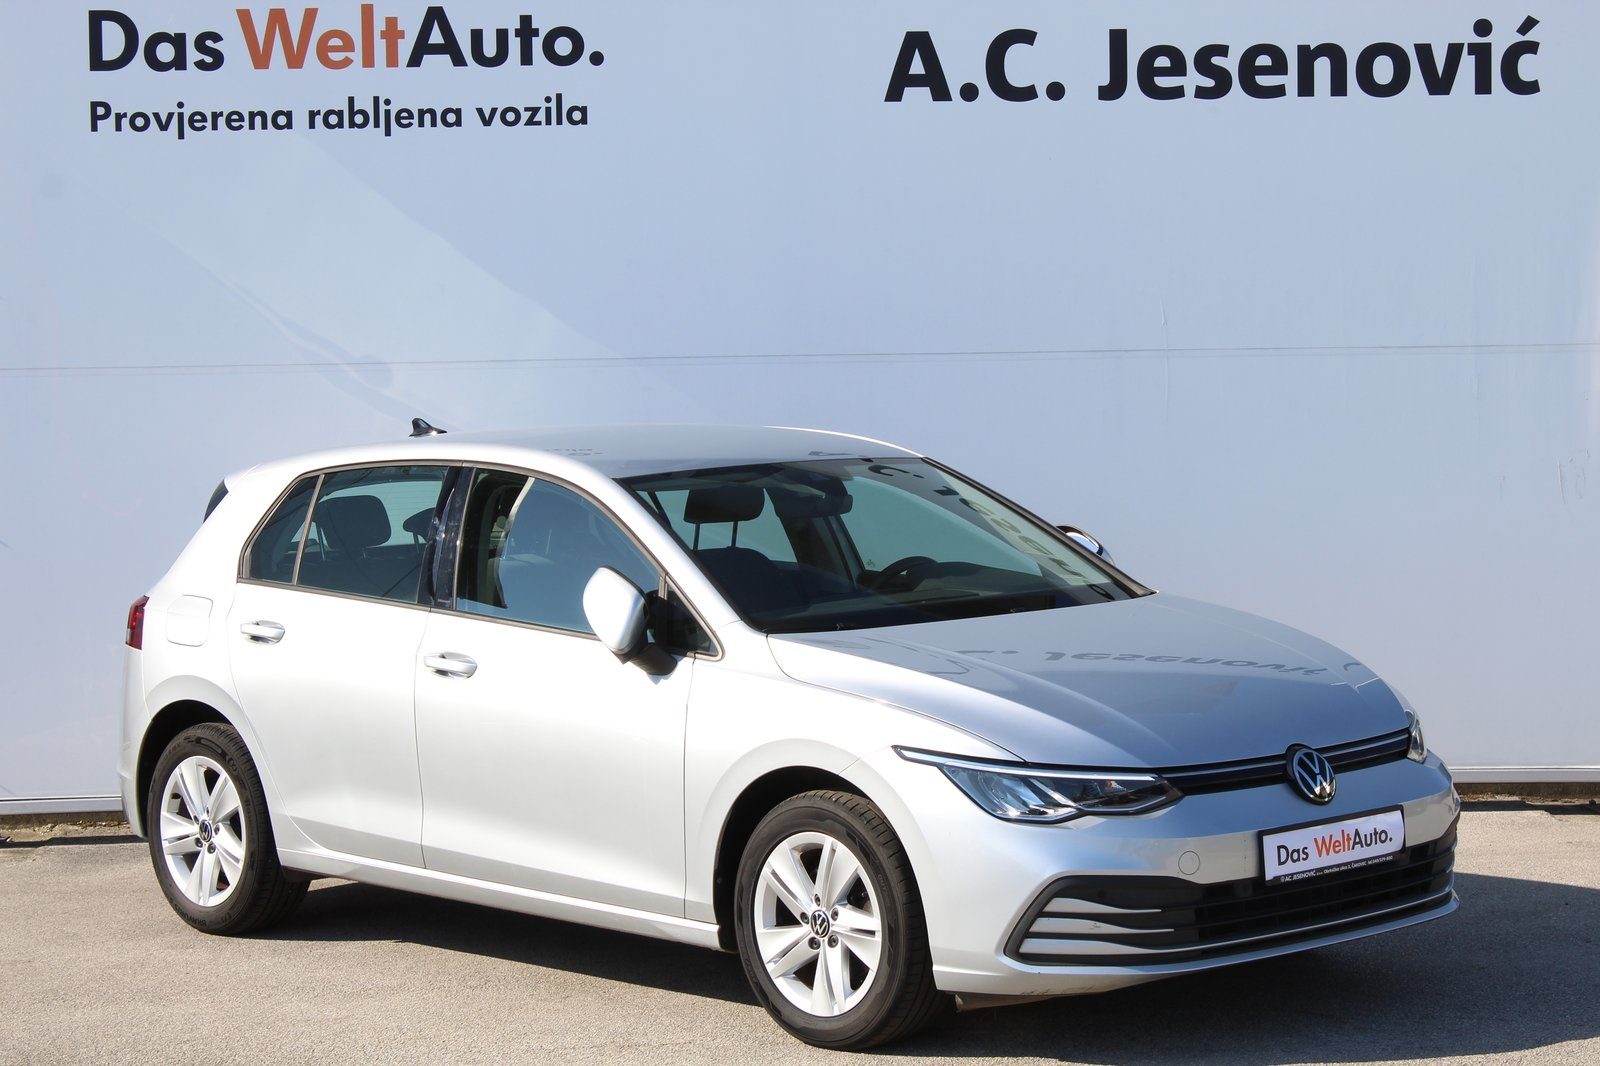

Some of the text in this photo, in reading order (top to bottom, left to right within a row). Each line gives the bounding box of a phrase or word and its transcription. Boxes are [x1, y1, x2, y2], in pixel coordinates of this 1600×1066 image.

[89, 3, 605, 72] Das WeltAuto.
[885, 15, 1541, 103] A.C. Jesenović
[90, 92, 588, 140] Provjerena rabljena vozila
[1276, 827, 1393, 867] Das WeltAuto.
